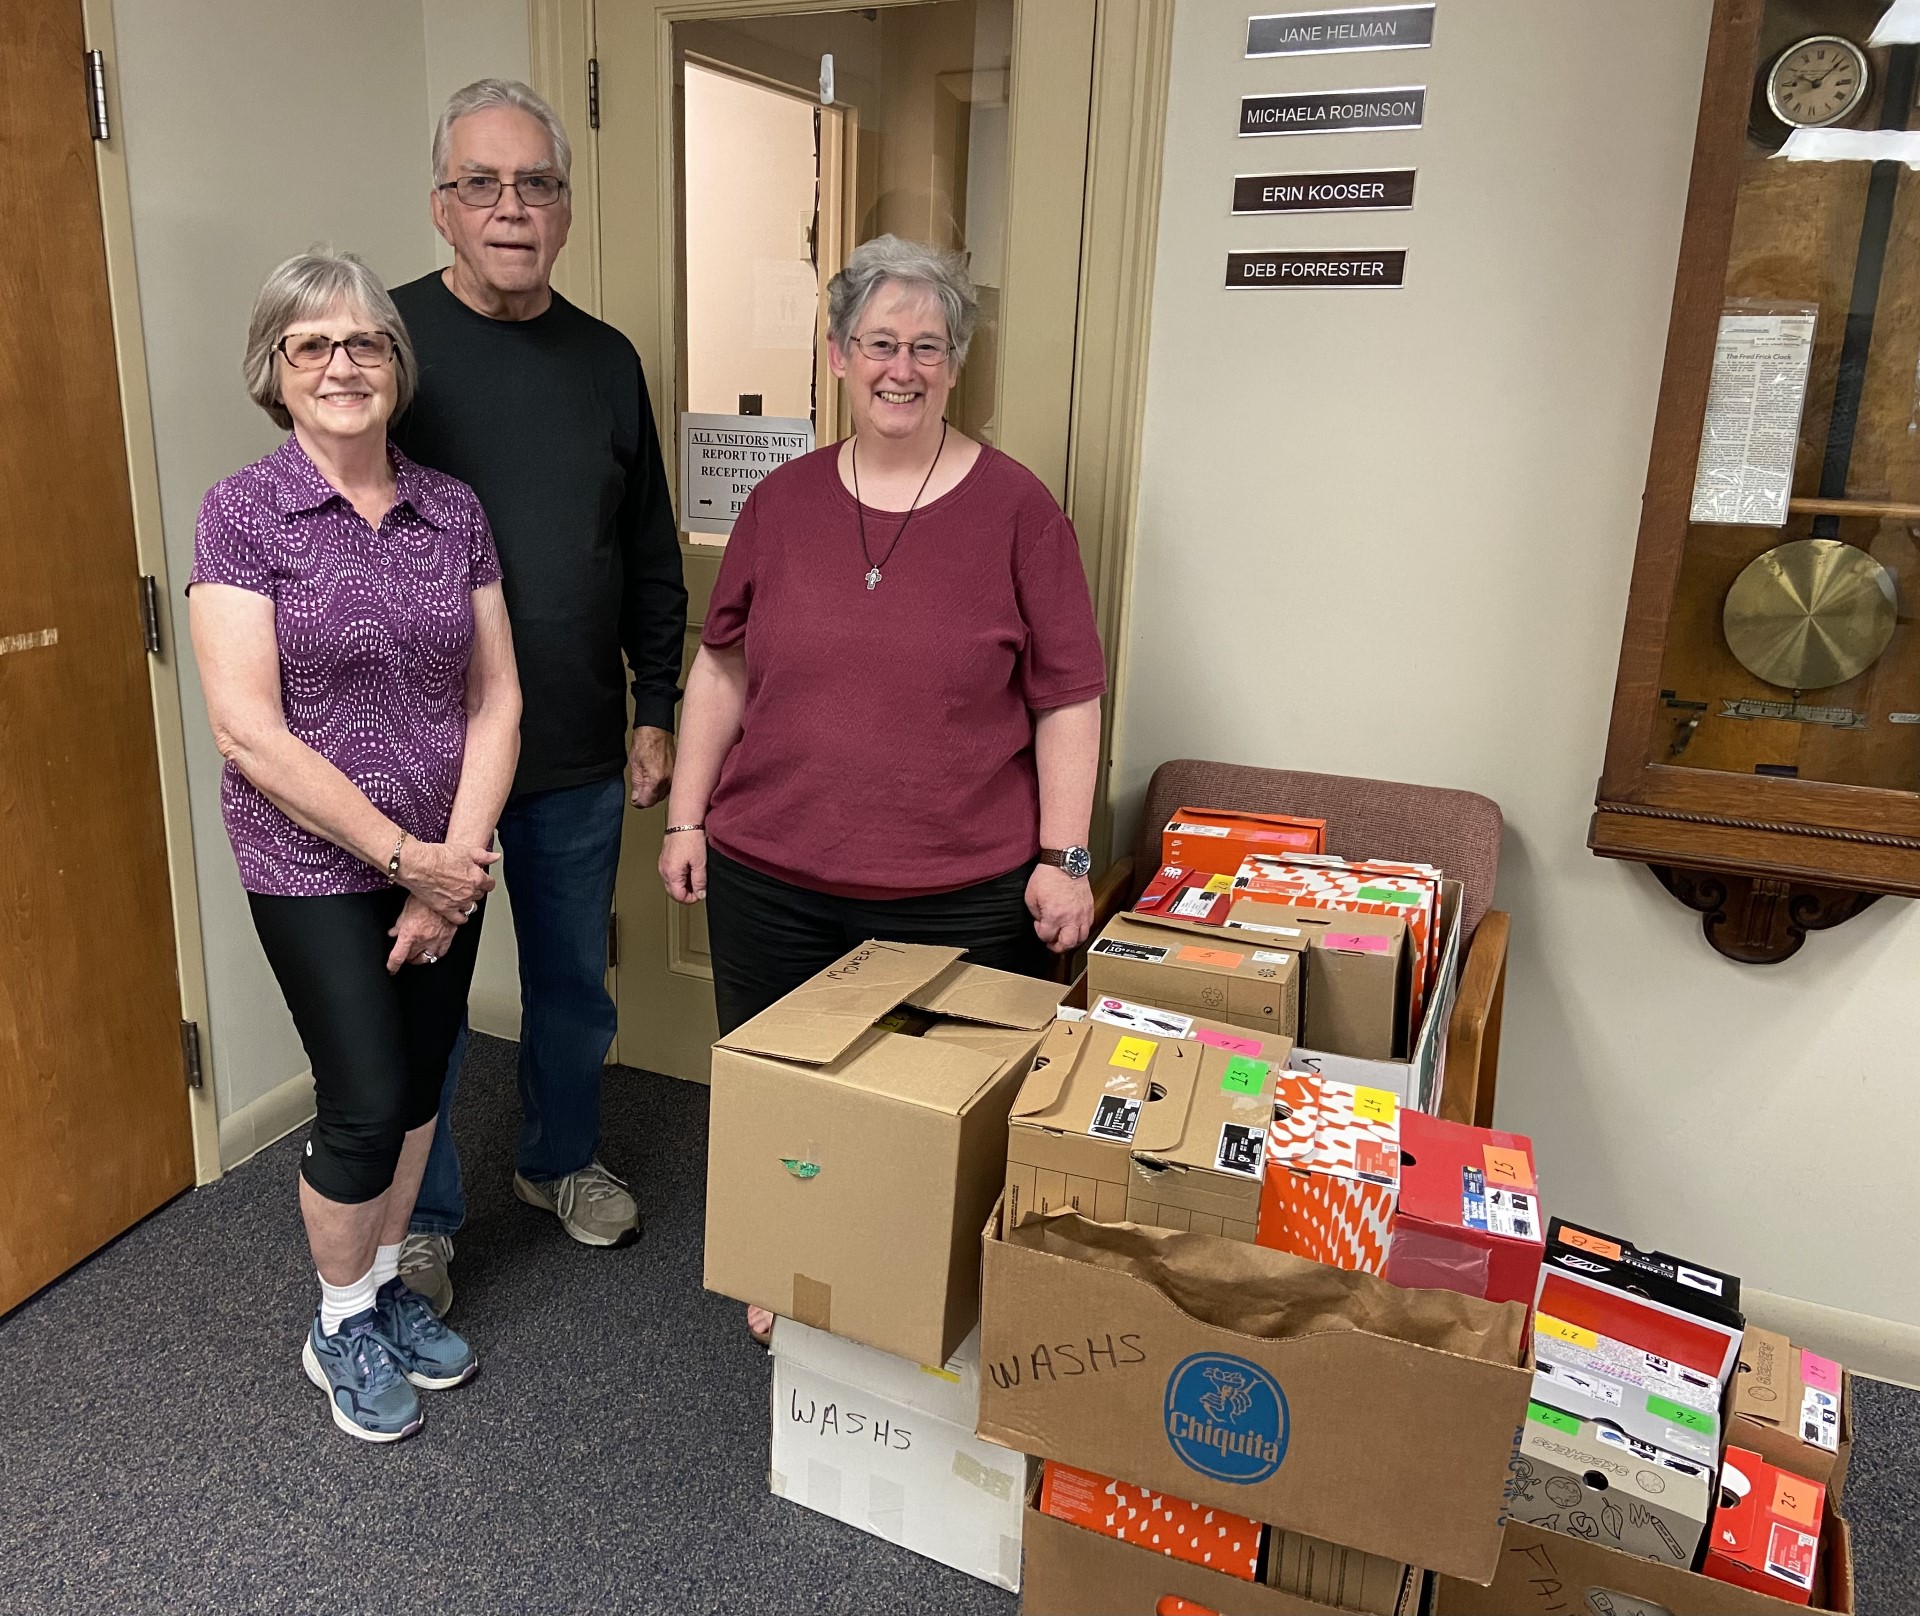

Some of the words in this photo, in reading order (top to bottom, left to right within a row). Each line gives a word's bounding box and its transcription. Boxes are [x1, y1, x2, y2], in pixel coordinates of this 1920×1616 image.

[1279, 26, 1322, 43] JANE
[1326, 21, 1397, 40] HELMAN
[1247, 106, 1326, 124] MICHAELA
[1329, 101, 1416, 119] ROBINSON
[1262, 186, 1304, 202] ERIN
[1308, 183, 1385, 200] KOOSER
[1243, 263, 1277, 278] DEB
[1281, 262, 1384, 277] FORRESTER
[691, 432, 714, 443] ALL
[716, 433, 769, 446] VISITORS
[771, 436, 805, 448] MUST
[702, 448, 747, 461] REPORT
[751, 451, 767, 462] TO
[769, 452, 793, 463] THE
[732, 483, 755, 494] DES
[989, 1333, 1147, 1389] WASHS
[790, 1388, 913, 1451] WASHS
[1168, 1410, 1280, 1464] Chiquita
[1531, 1436, 1630, 1477] SKECHERS
